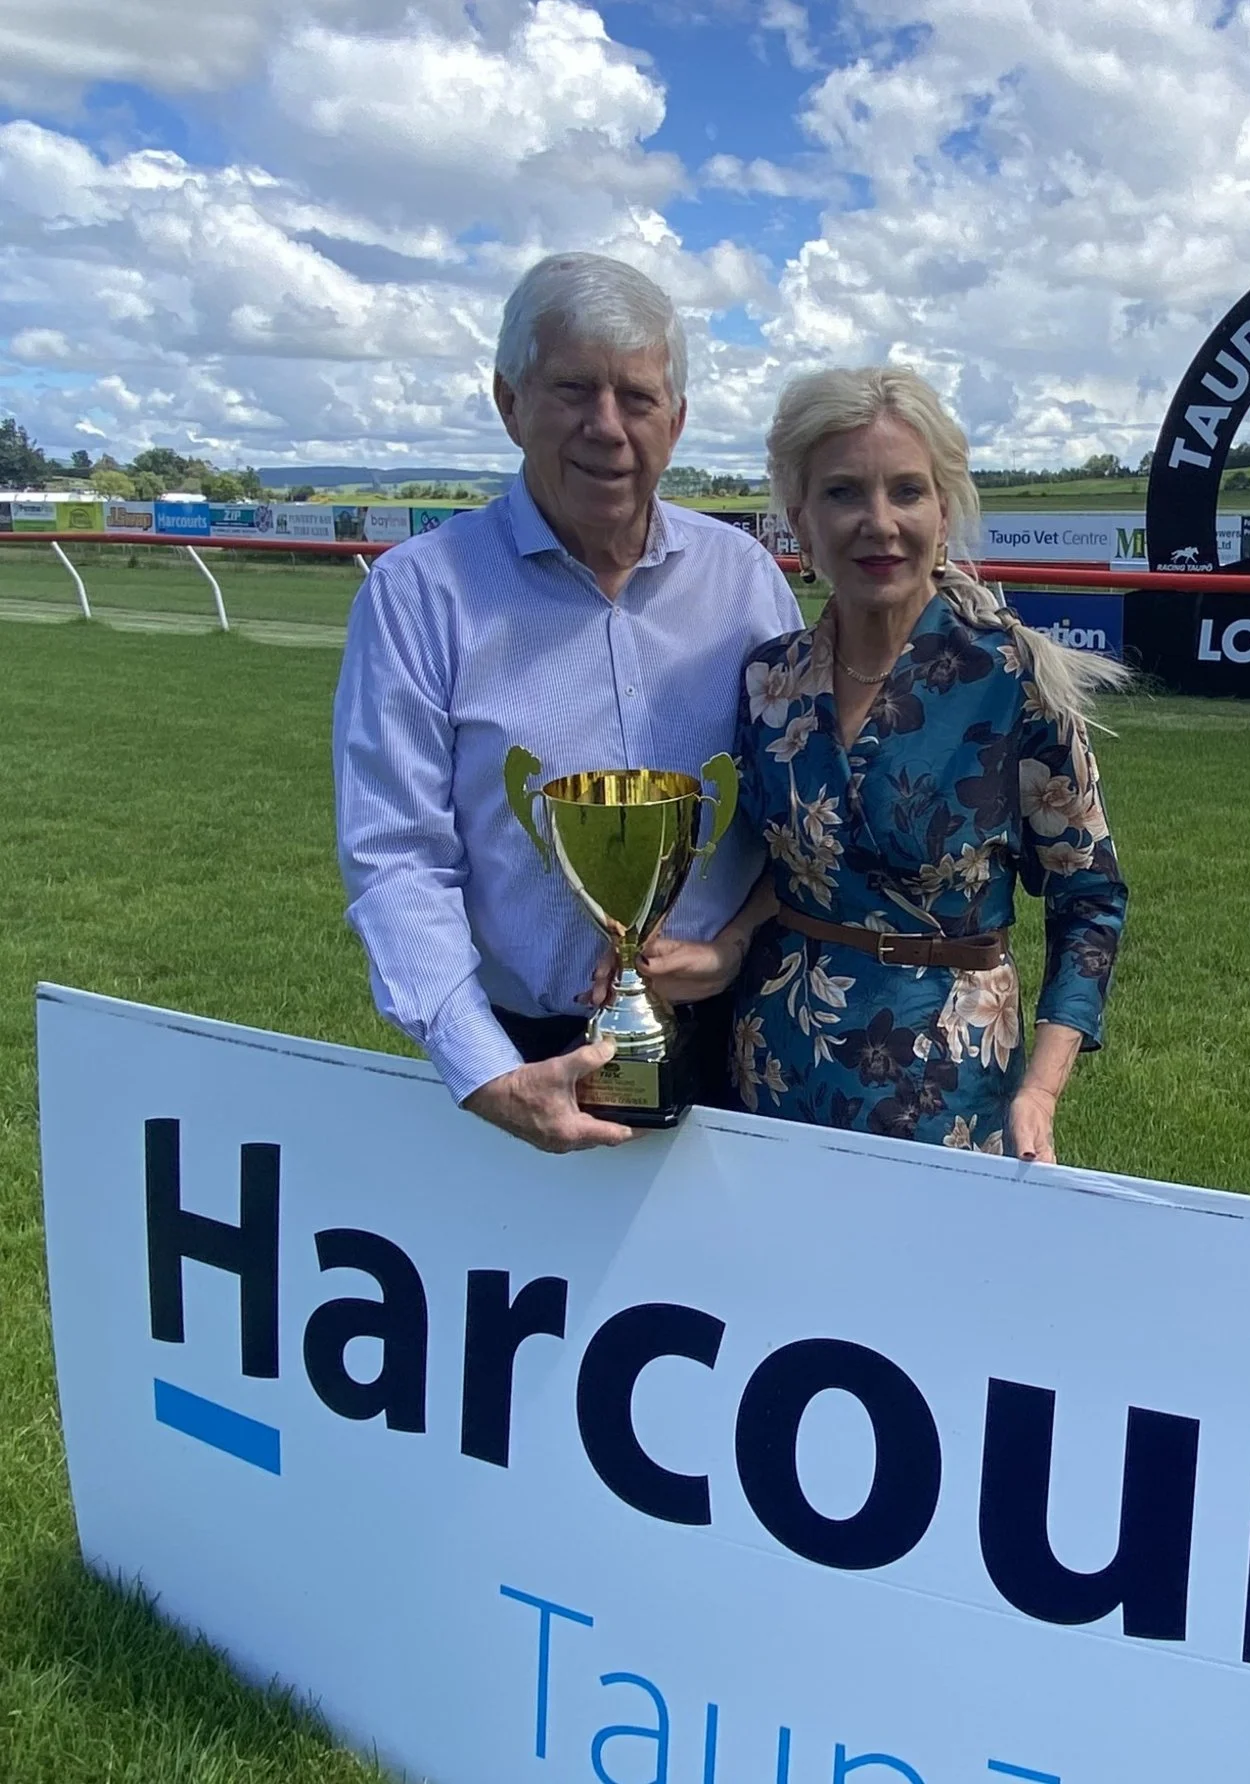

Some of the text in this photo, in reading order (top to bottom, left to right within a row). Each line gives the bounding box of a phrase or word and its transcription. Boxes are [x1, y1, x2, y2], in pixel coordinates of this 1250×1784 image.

[157, 513, 208, 529] Harcourts
[223, 510, 241, 521] ZIP
[988, 529, 1108, 548] Taupō Vet Centre
[1156, 563, 1186, 571] RACING
